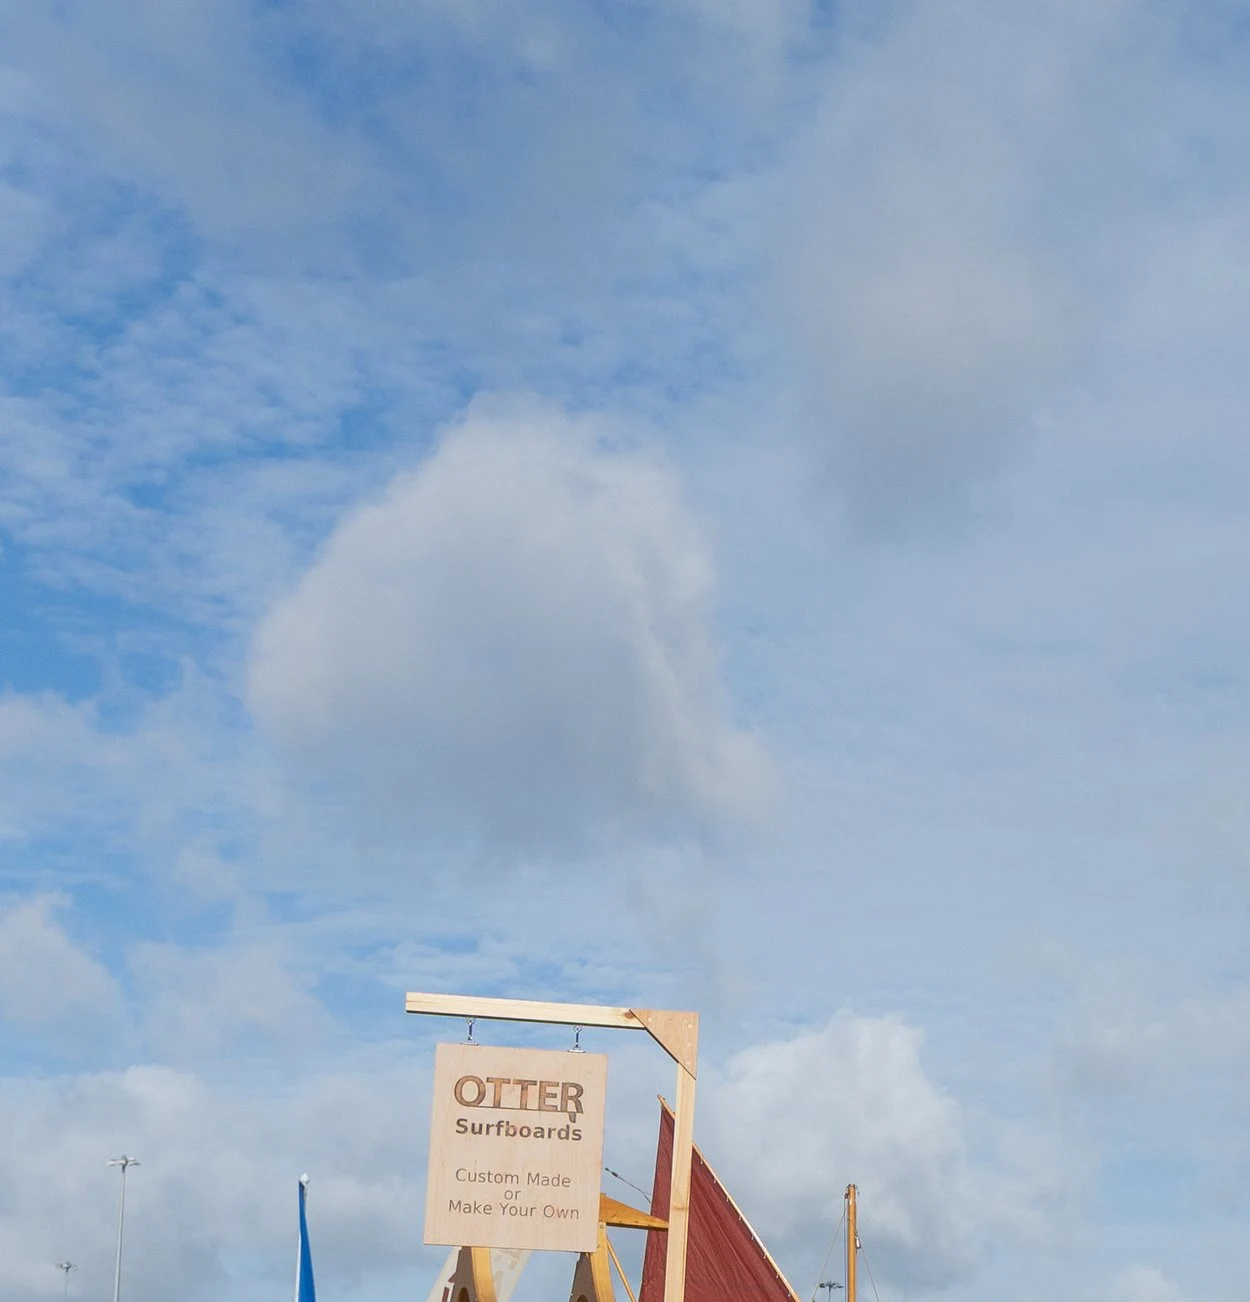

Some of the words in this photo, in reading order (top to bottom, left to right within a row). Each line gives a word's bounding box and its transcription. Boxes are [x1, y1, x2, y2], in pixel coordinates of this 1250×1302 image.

[454, 1075, 584, 1115] OTTER
[455, 1118, 583, 1141] Surfboards
[455, 1168, 520, 1185] Custom
[527, 1172, 571, 1188] Made
[503, 1189, 522, 1201] or
[448, 1199, 493, 1215] Make
[499, 1202, 537, 1217] Your
[543, 1204, 580, 1220] Own
